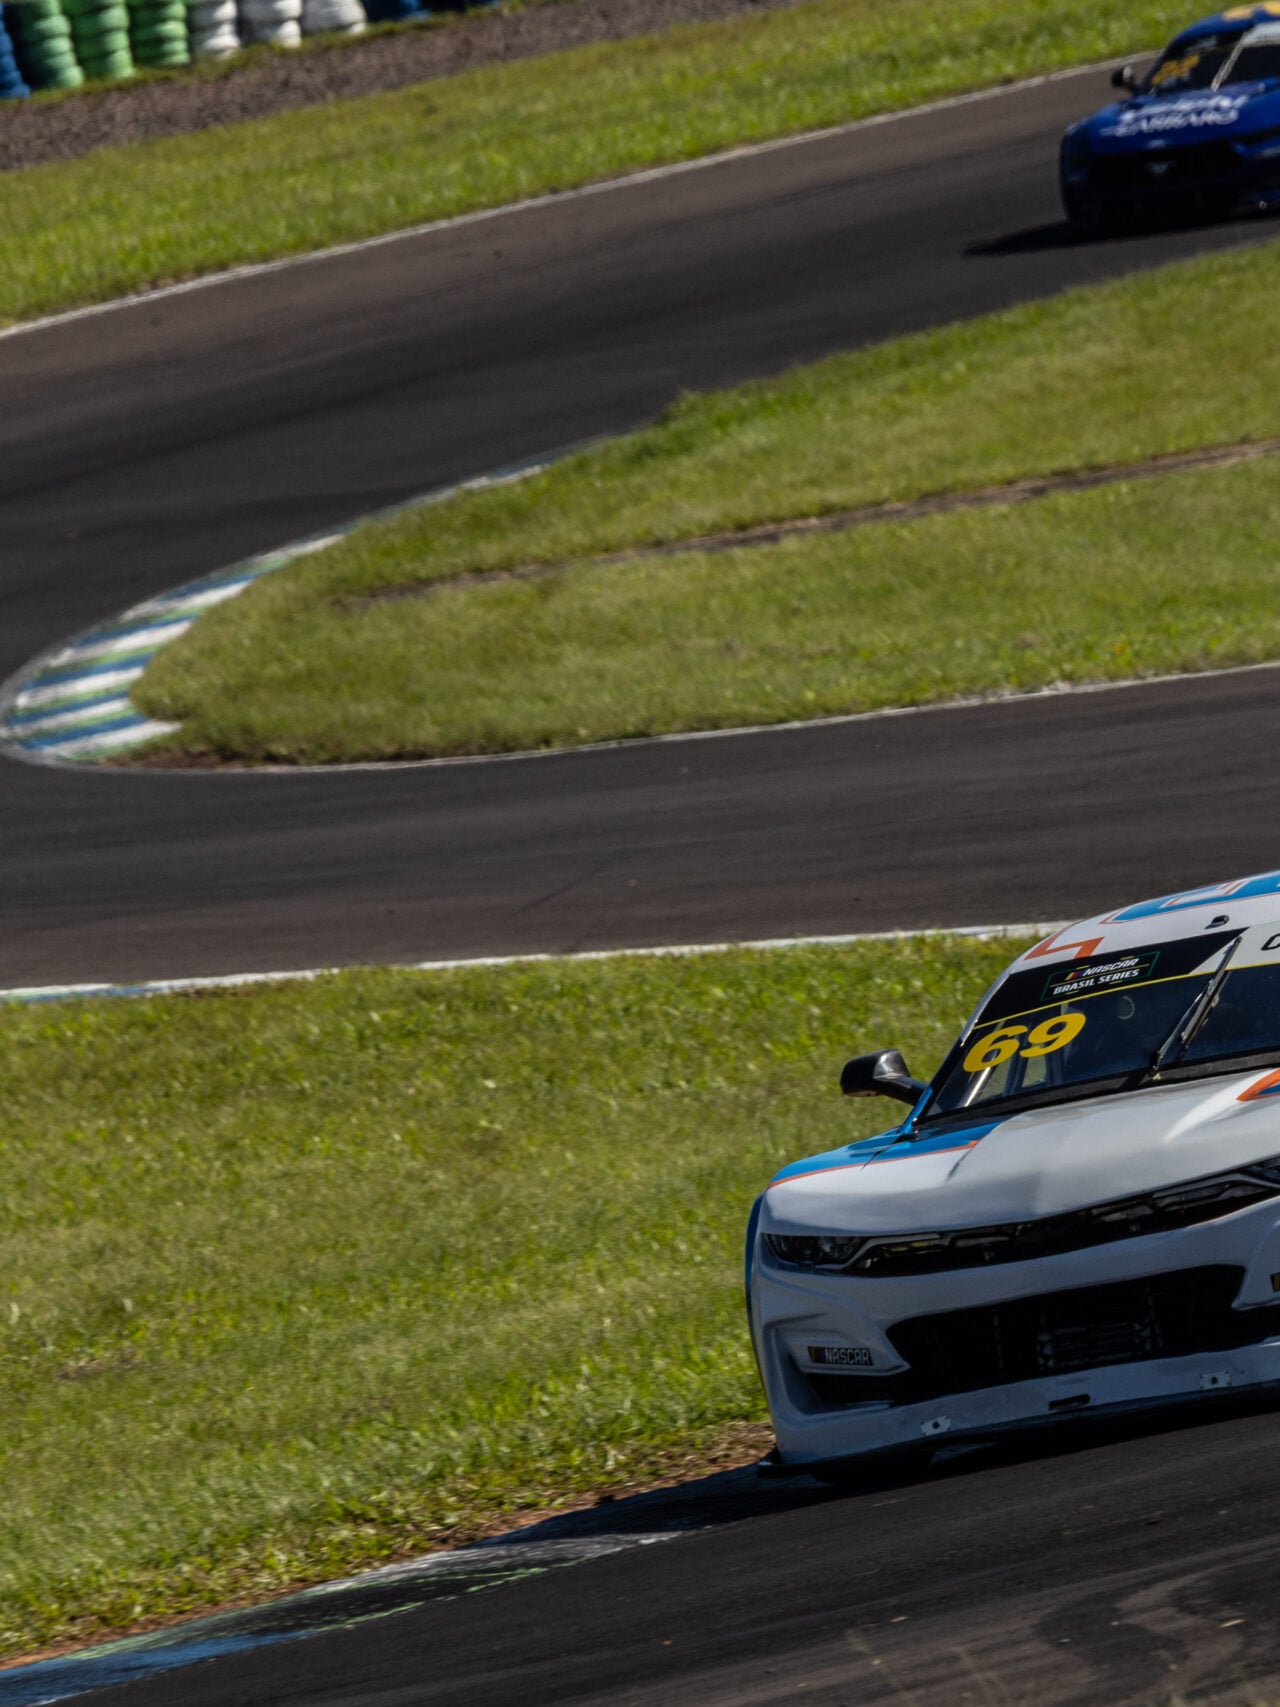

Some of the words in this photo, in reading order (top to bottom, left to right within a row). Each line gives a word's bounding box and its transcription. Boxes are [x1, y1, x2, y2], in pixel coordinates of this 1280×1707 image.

[1082, 957, 1140, 977] NASCAR
[1053, 979, 1095, 995] BRASIL
[1097, 968, 1140, 984] SERIES
[963, 1012, 1087, 1073] 69
[824, 1347, 871, 1366] NASCAR
